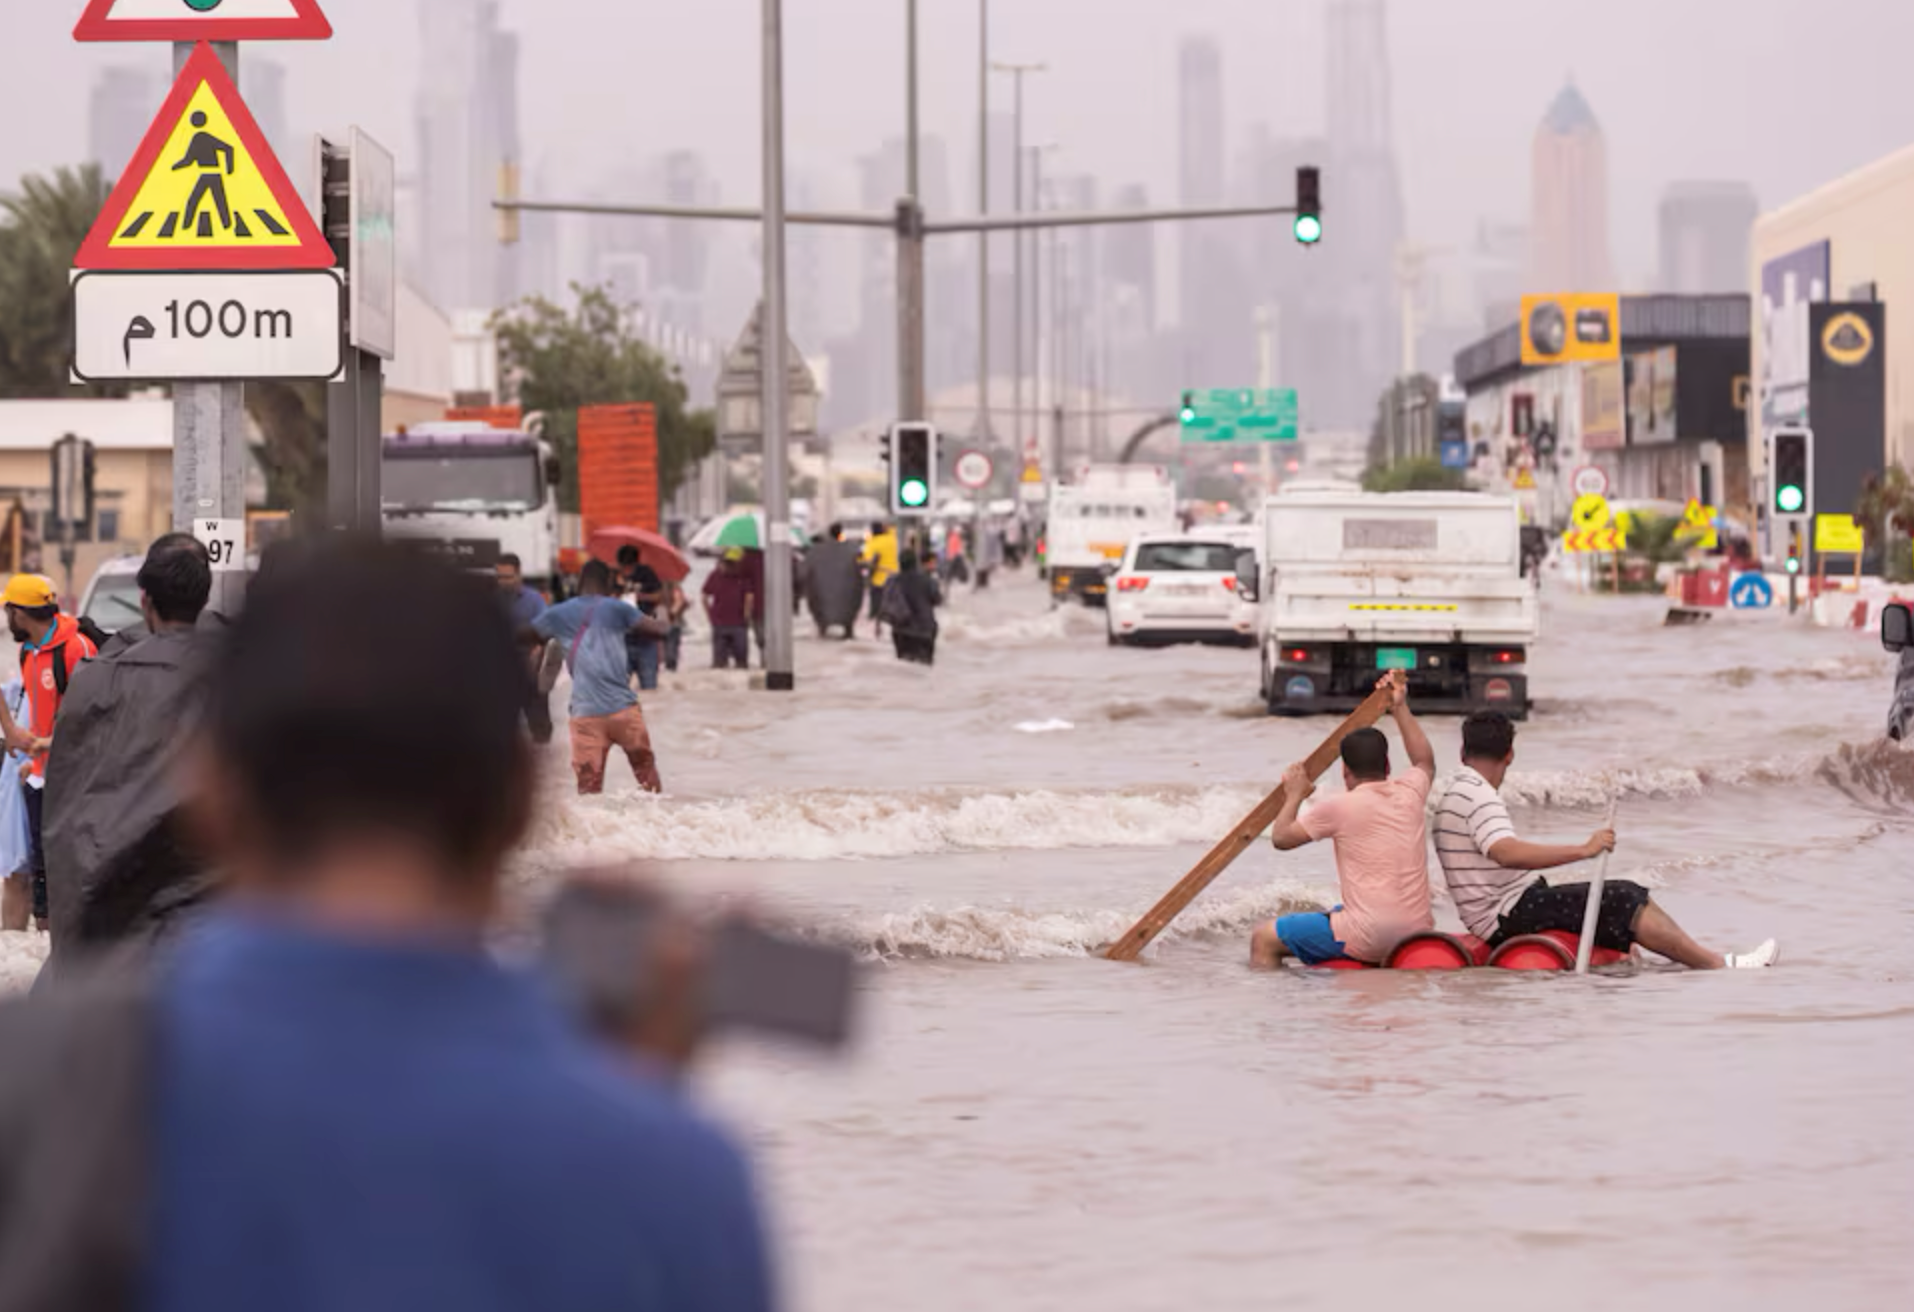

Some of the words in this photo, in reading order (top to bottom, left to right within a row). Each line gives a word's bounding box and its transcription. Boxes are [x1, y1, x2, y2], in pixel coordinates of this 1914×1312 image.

[123, 315, 156, 370] م
[205, 521, 219, 531] W
[208, 539, 234, 565] 97
